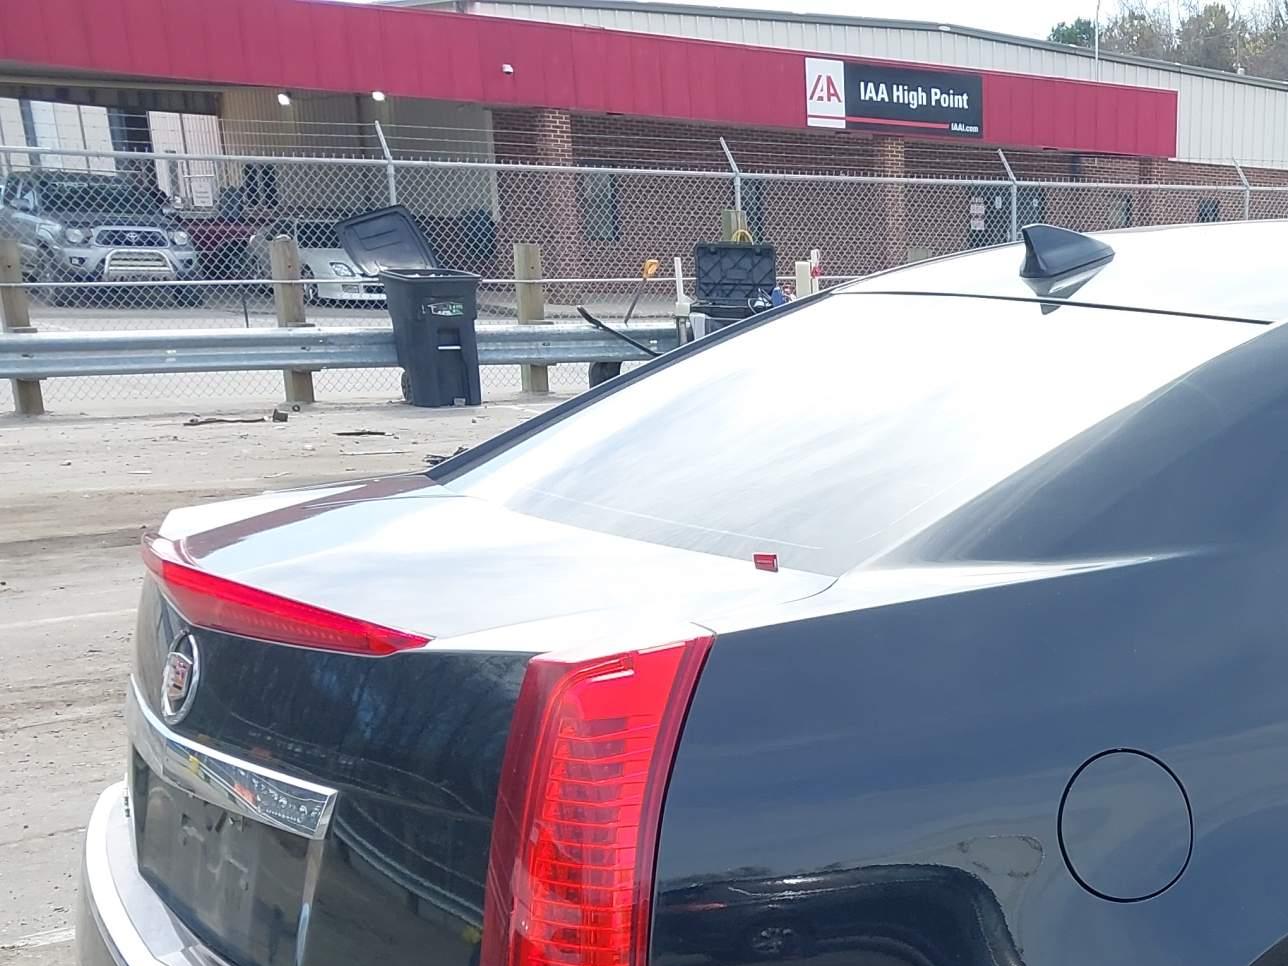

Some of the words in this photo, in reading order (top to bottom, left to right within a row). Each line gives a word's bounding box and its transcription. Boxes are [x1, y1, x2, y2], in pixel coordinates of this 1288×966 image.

[860, 81, 889, 103] IAA
[893, 84, 927, 109] High
[931, 87, 969, 109] Point
